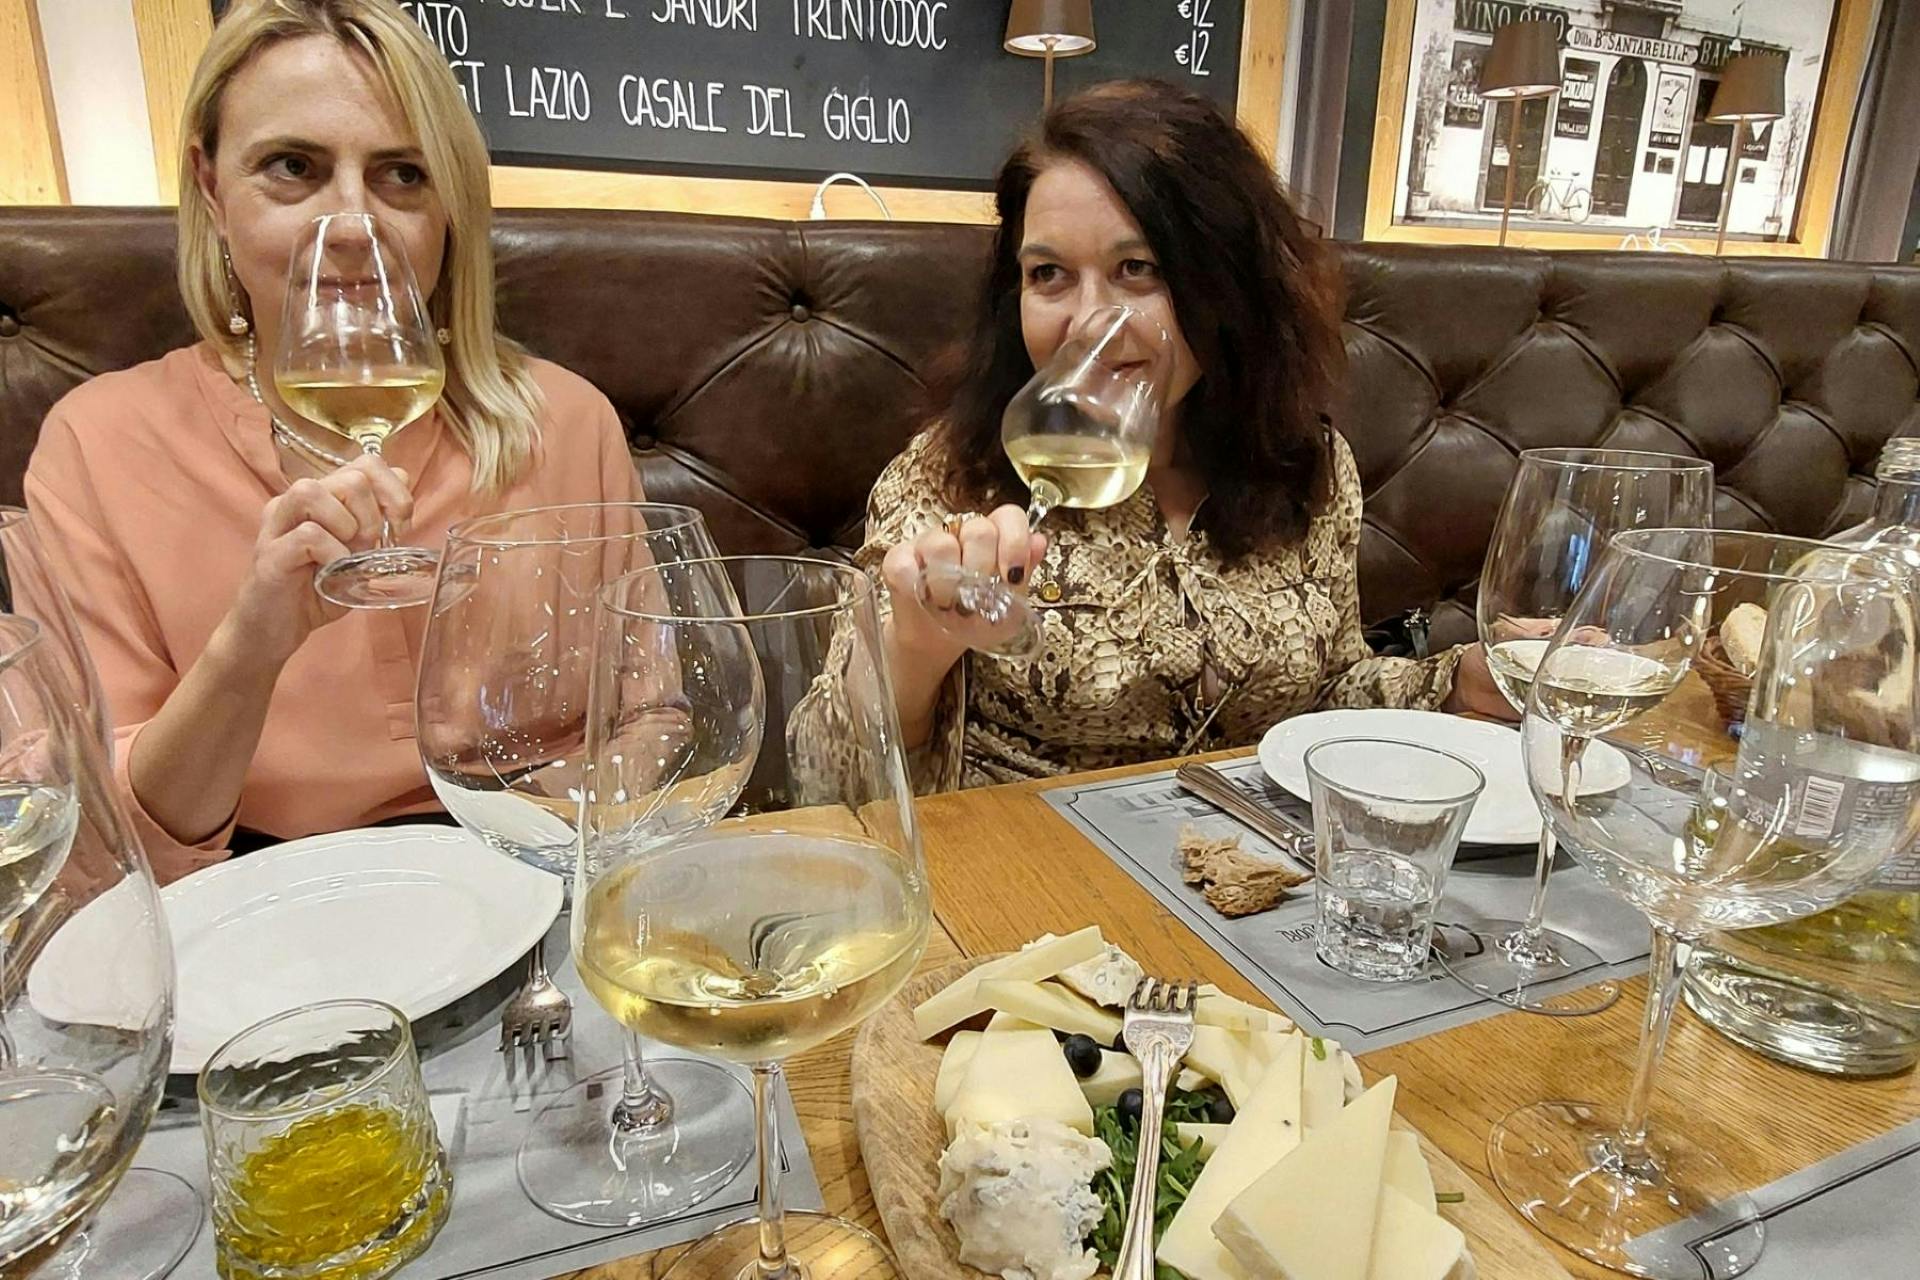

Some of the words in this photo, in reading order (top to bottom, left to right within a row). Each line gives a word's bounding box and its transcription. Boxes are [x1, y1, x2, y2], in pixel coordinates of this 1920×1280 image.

[400, 2, 468, 56] ATO
[1174, 30, 1210, 75] €12
[505, 64, 590, 121] LAZIO
[618, 74, 727, 133] CASALE
[742, 84, 806, 138] DEL
[823, 92, 911, 144] GIGLIO
